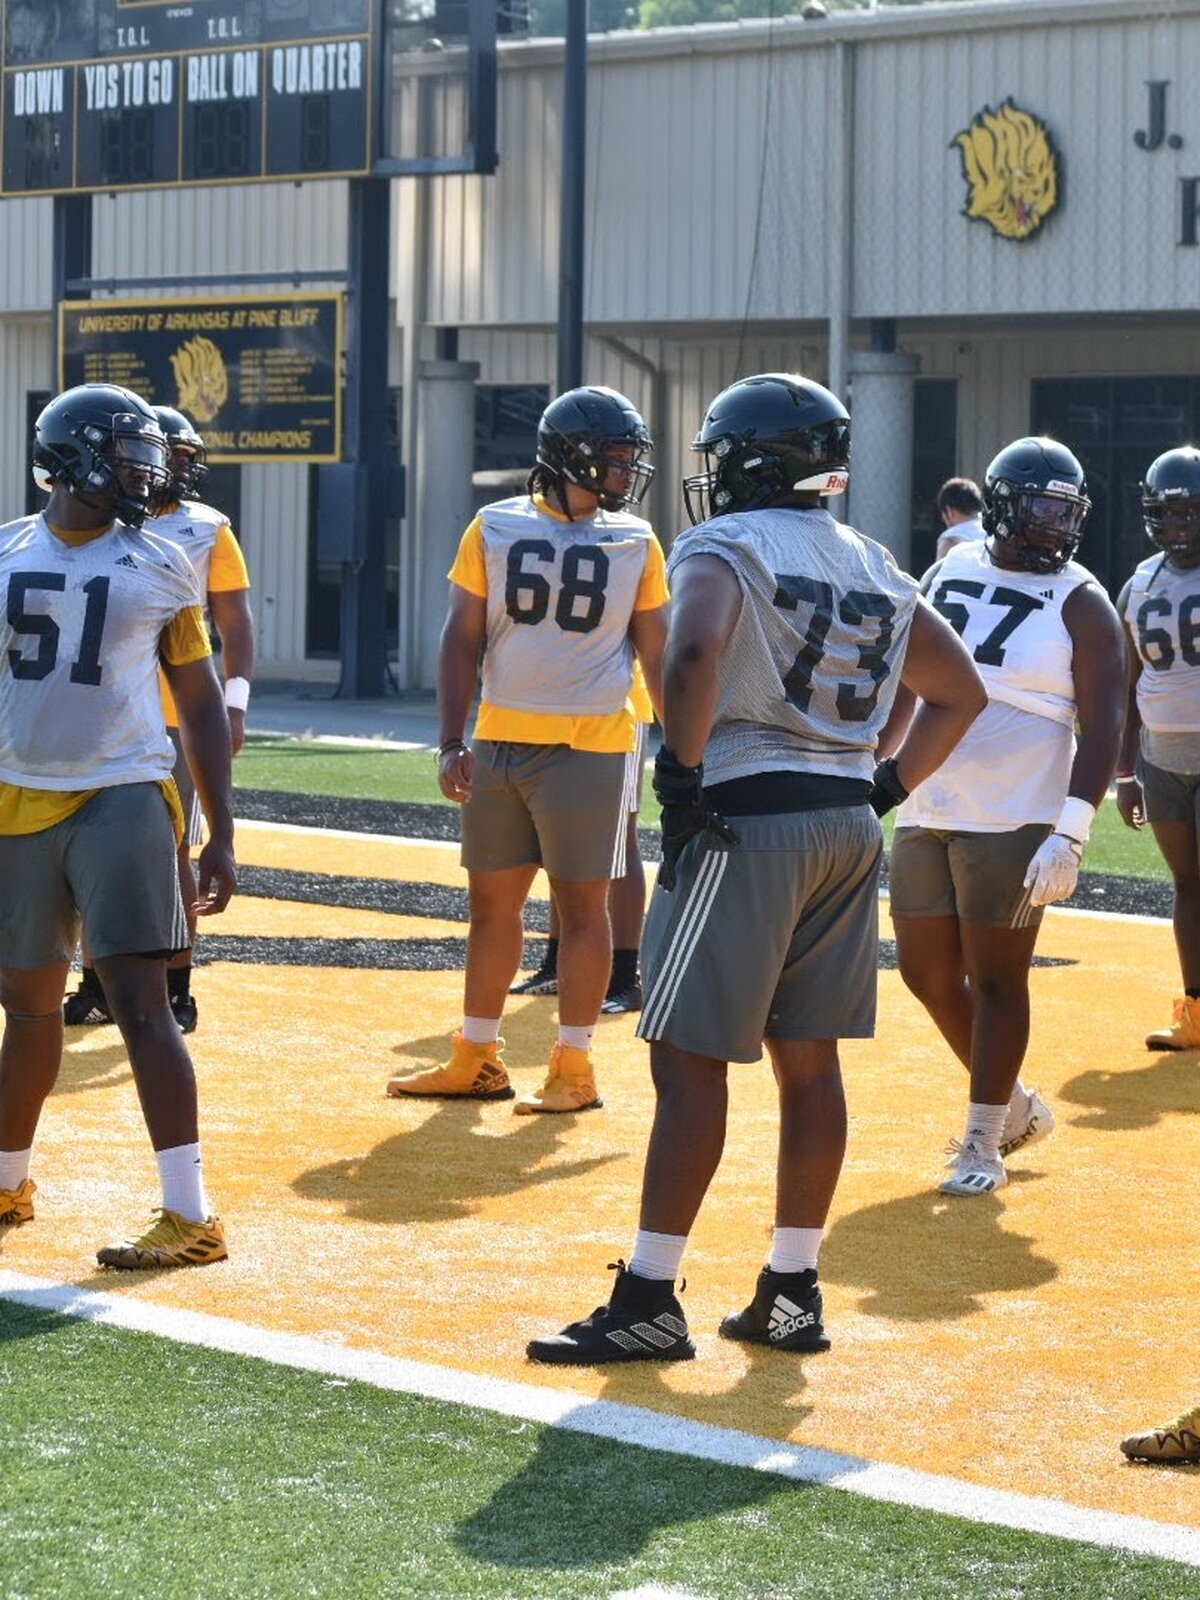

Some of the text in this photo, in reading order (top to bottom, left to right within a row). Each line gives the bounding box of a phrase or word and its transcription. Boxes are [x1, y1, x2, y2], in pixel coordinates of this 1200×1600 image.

[14, 67, 64, 116] DOWN
[85, 58, 173, 110] YDS TO GO
[187, 51, 259, 102] BALL ON
[272, 41, 362, 95] QUARTER
[1133, 78, 1185, 152] J.
[78, 306, 320, 333] UNIVERSITY OF ARKANSAS AT PINE BLUFF
[238, 430, 312, 449] CHAMPIONS
[505, 538, 610, 634] 68
[6, 571, 111, 687] 51
[772, 572, 897, 722] 73
[768, 1311, 816, 1343] adidas
